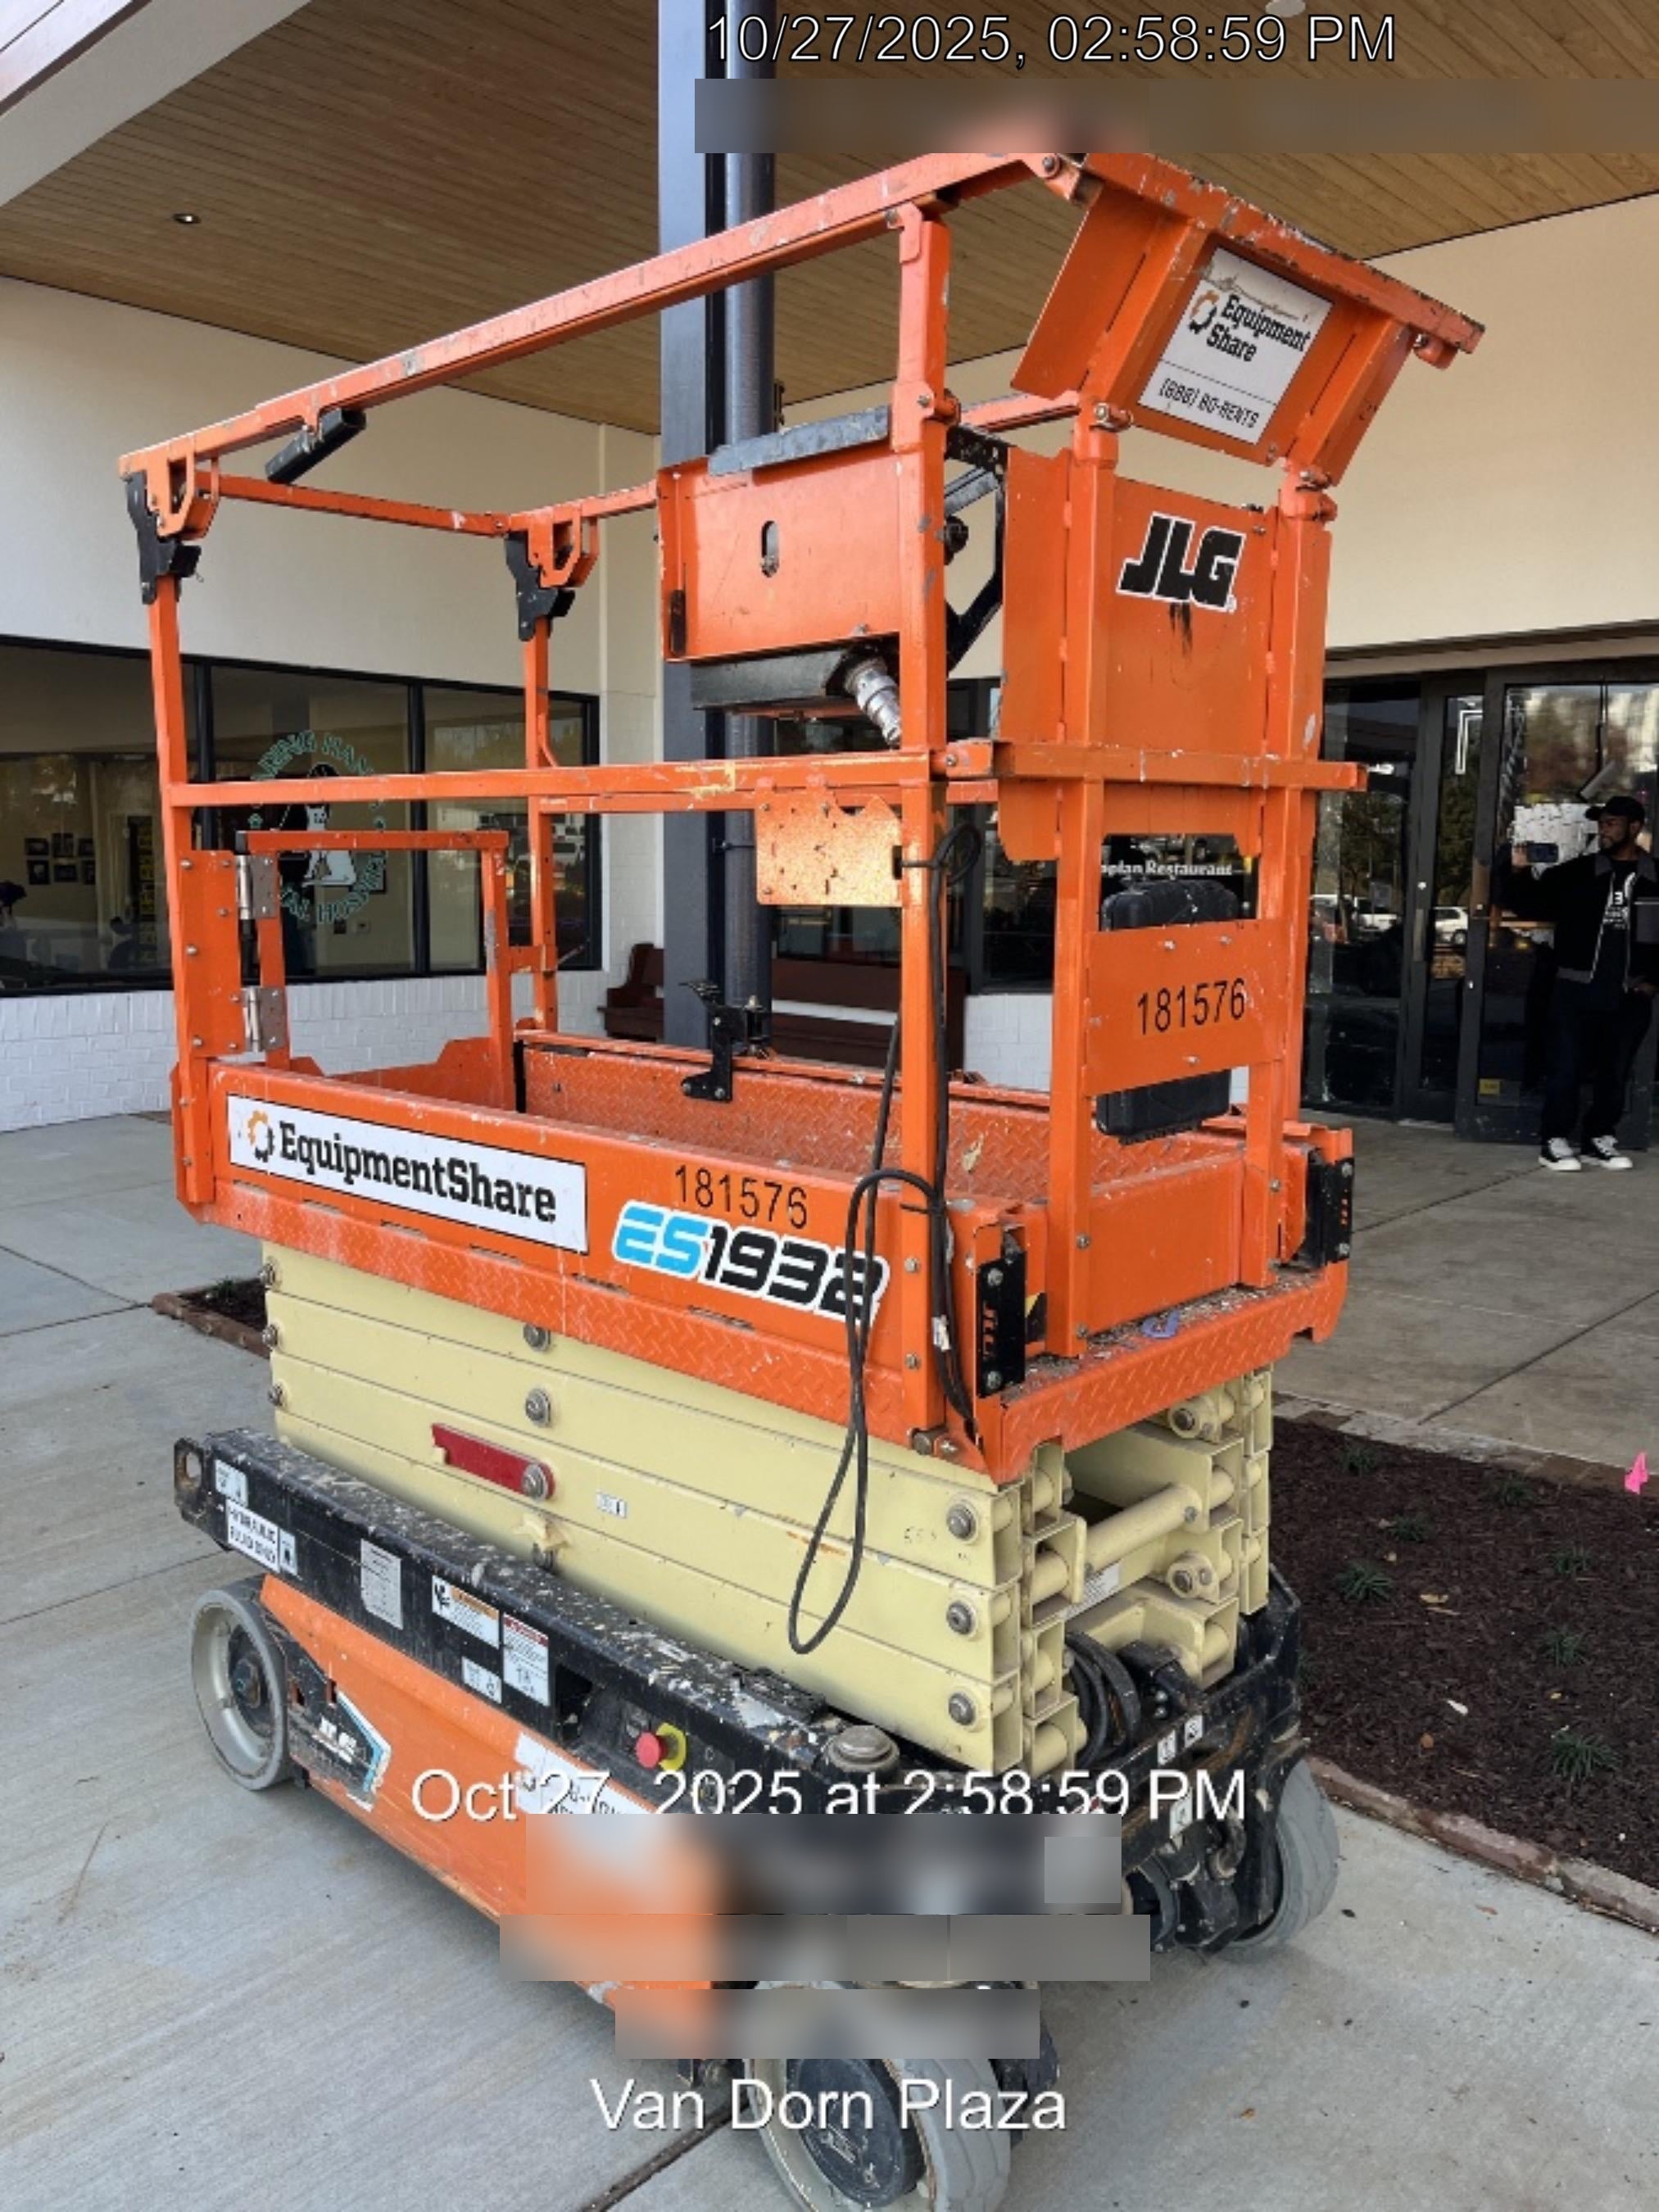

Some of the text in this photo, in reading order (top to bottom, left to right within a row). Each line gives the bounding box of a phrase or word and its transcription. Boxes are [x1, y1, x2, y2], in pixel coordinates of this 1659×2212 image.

[1206, 323, 1258, 362] Share
[1221, 294, 1312, 352] Equipment
[1116, 511, 1247, 612] JLG
[1145, 859, 1232, 877] Restaurant
[1137, 977, 1245, 1035] 181576
[279, 1121, 556, 1223] EquipmentShare
[675, 1165, 807, 1229] 181576
[613, 1201, 889, 1324] ES1932
